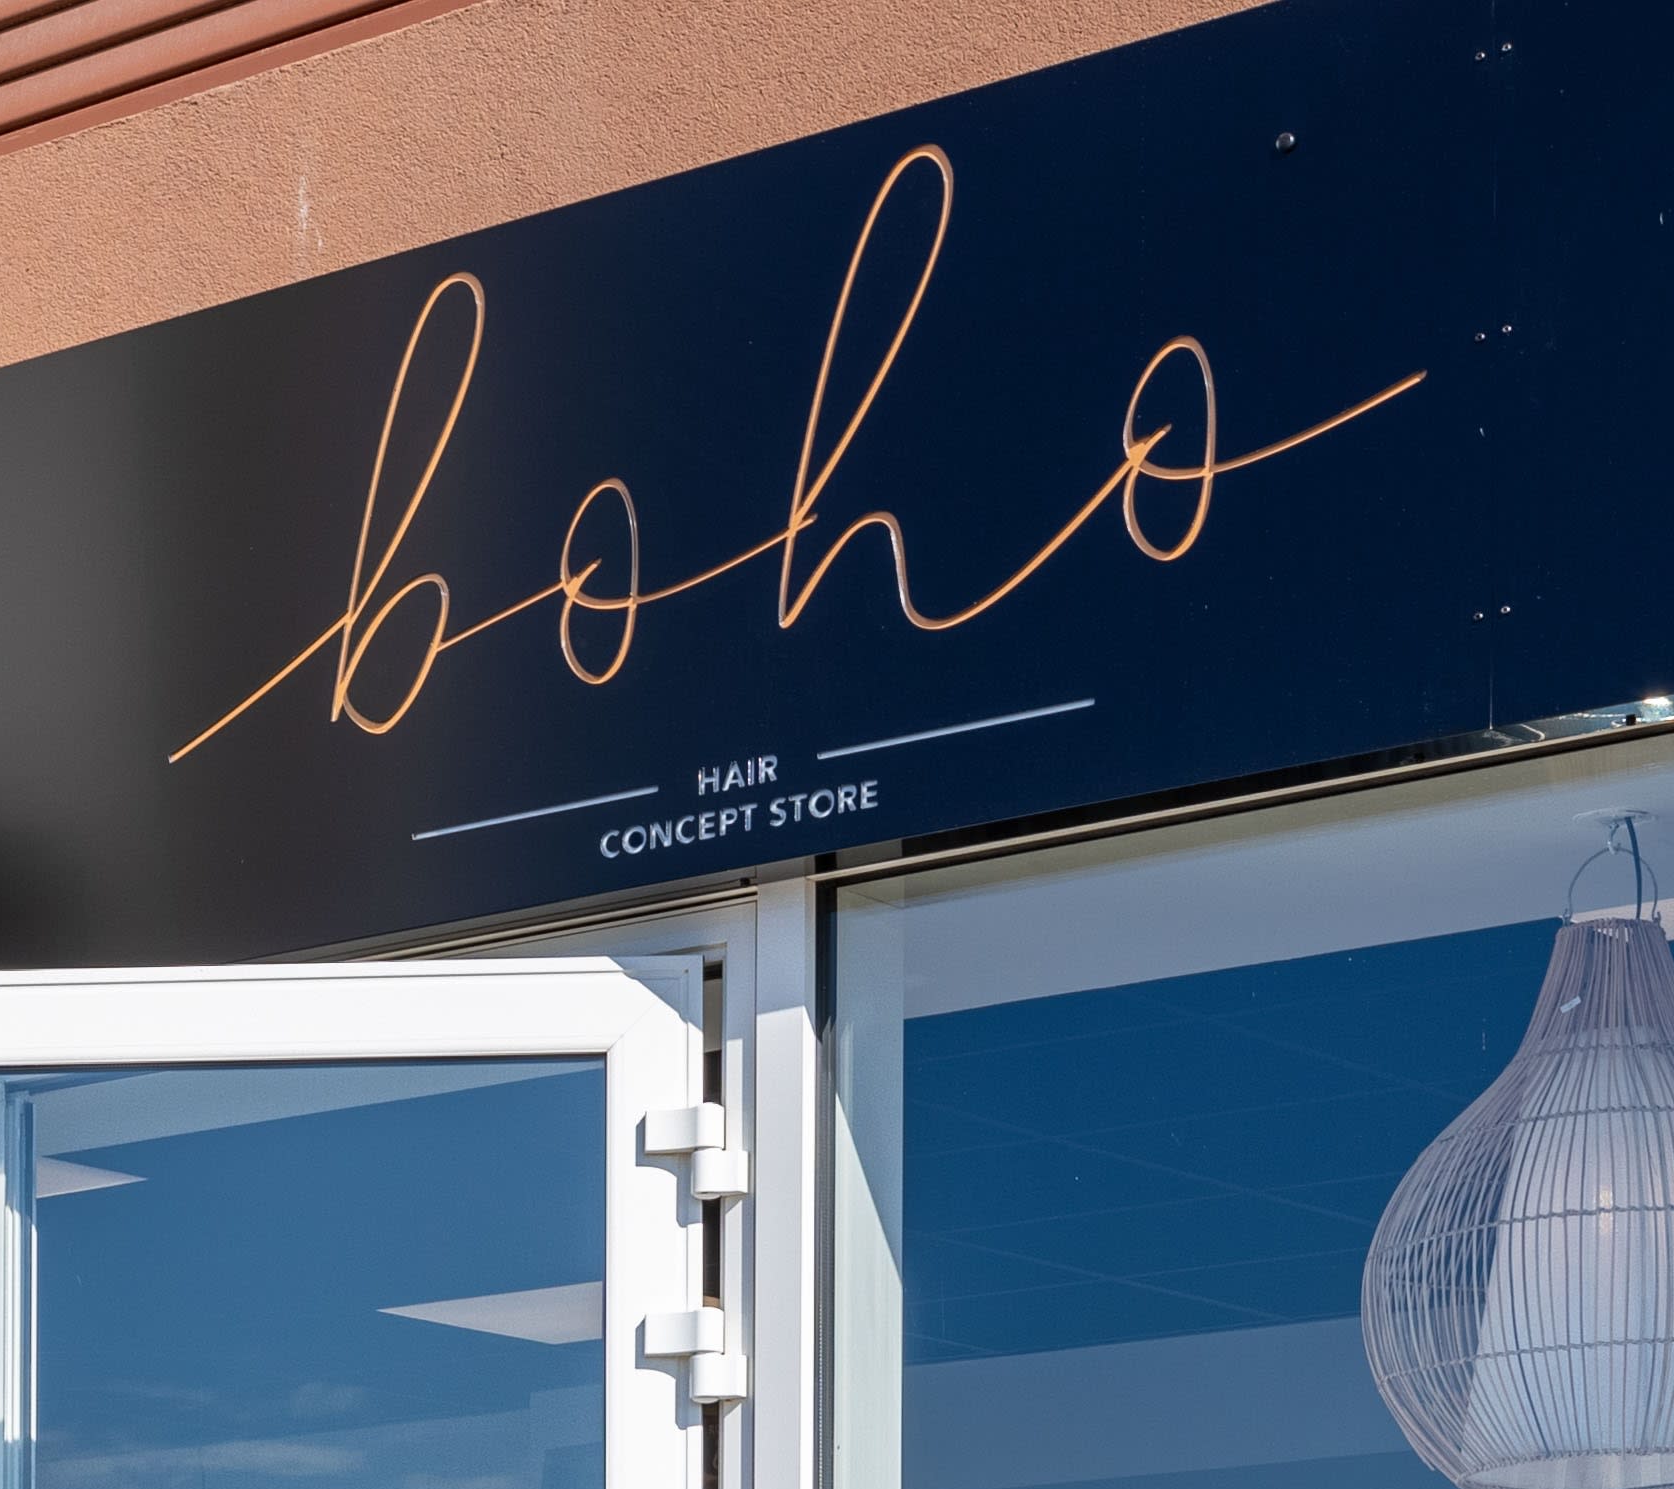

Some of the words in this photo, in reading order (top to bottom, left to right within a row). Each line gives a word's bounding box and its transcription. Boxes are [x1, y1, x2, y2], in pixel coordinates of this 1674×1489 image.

[167, 143, 1428, 765] boho
[698, 754, 778, 796] HAIR
[600, 803, 758, 859] CONCEPT
[769, 780, 879, 828] STORE
